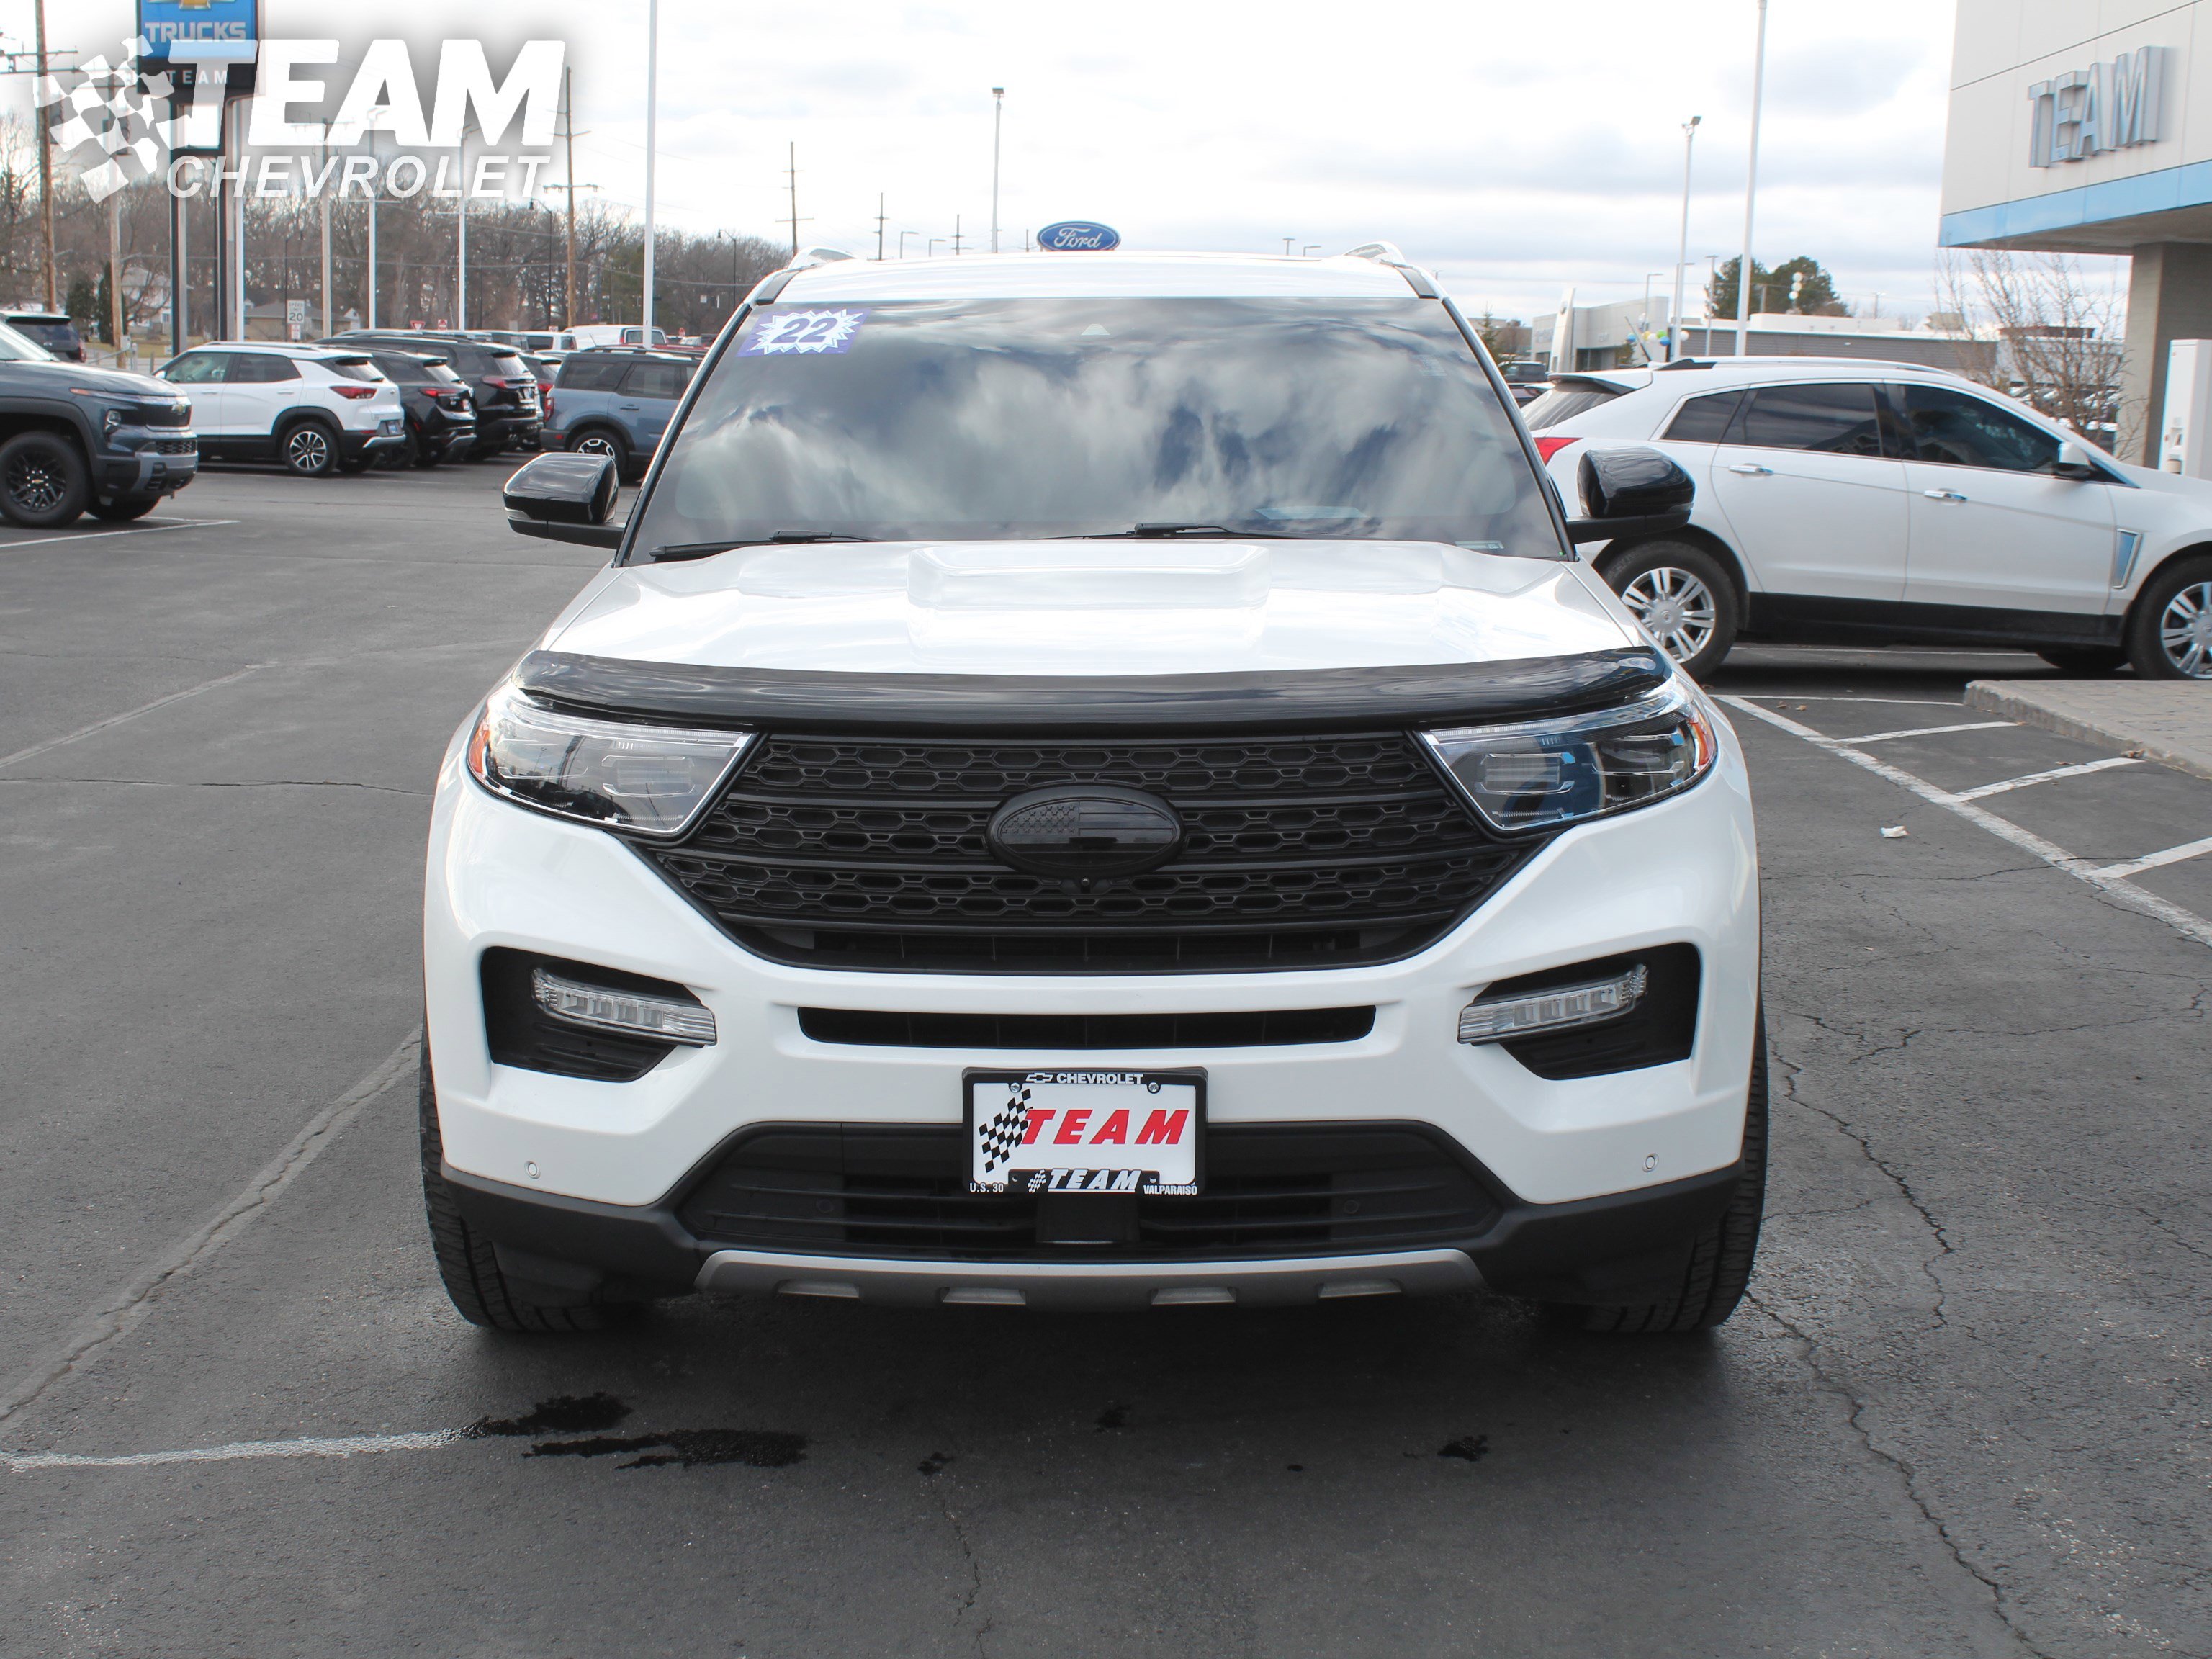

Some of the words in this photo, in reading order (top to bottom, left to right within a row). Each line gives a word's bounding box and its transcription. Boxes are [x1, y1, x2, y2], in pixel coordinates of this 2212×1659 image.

[145, 22, 246, 43] TRUCKS
[166, 70, 227, 84] TEAM
[2028, 45, 2166, 168] TEAM
[1053, 227, 1102, 248] Ford
[289, 312, 303, 321] 20
[770, 317, 838, 343] 22
[1056, 1073, 1143, 1084] CHEVROLET
[1020, 1109, 1190, 1145] TEAM
[969, 1182, 989, 1192] U.S.
[992, 1183, 1004, 1193] 30
[1048, 1168, 1141, 1190] TEAM
[1143, 1184, 1198, 1195] VALPARAISO
